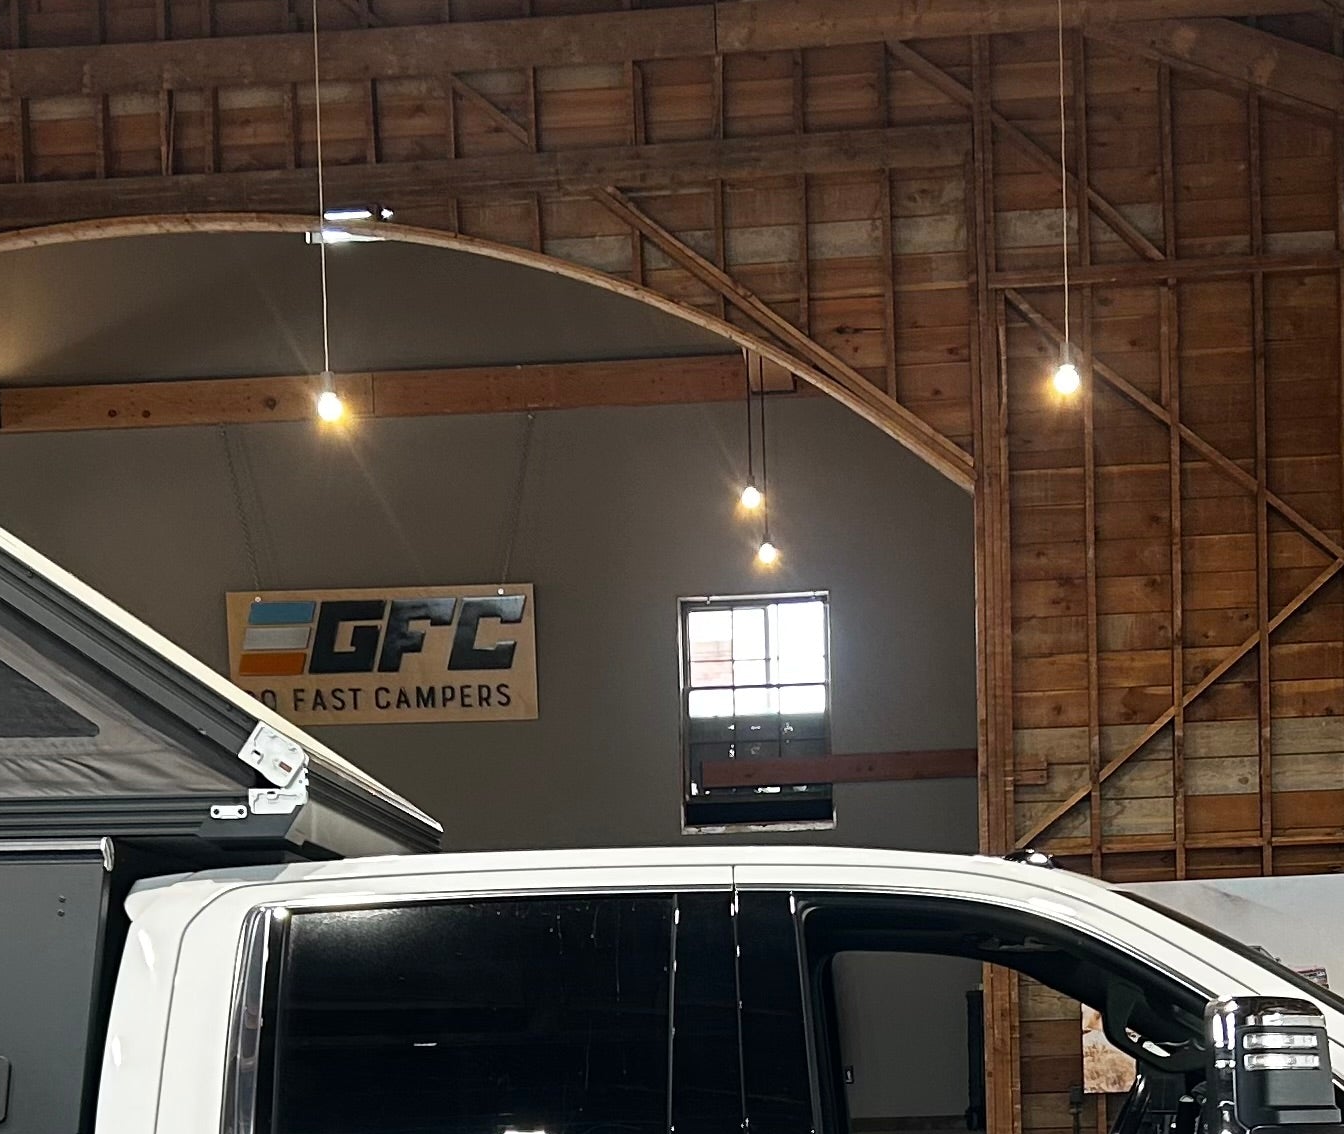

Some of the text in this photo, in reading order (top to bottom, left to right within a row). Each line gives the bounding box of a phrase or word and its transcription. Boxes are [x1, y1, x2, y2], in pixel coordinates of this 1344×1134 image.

[309, 595, 526, 674] GFC
[293, 687, 362, 712] FAST
[374, 684, 512, 711] CAMPERS
